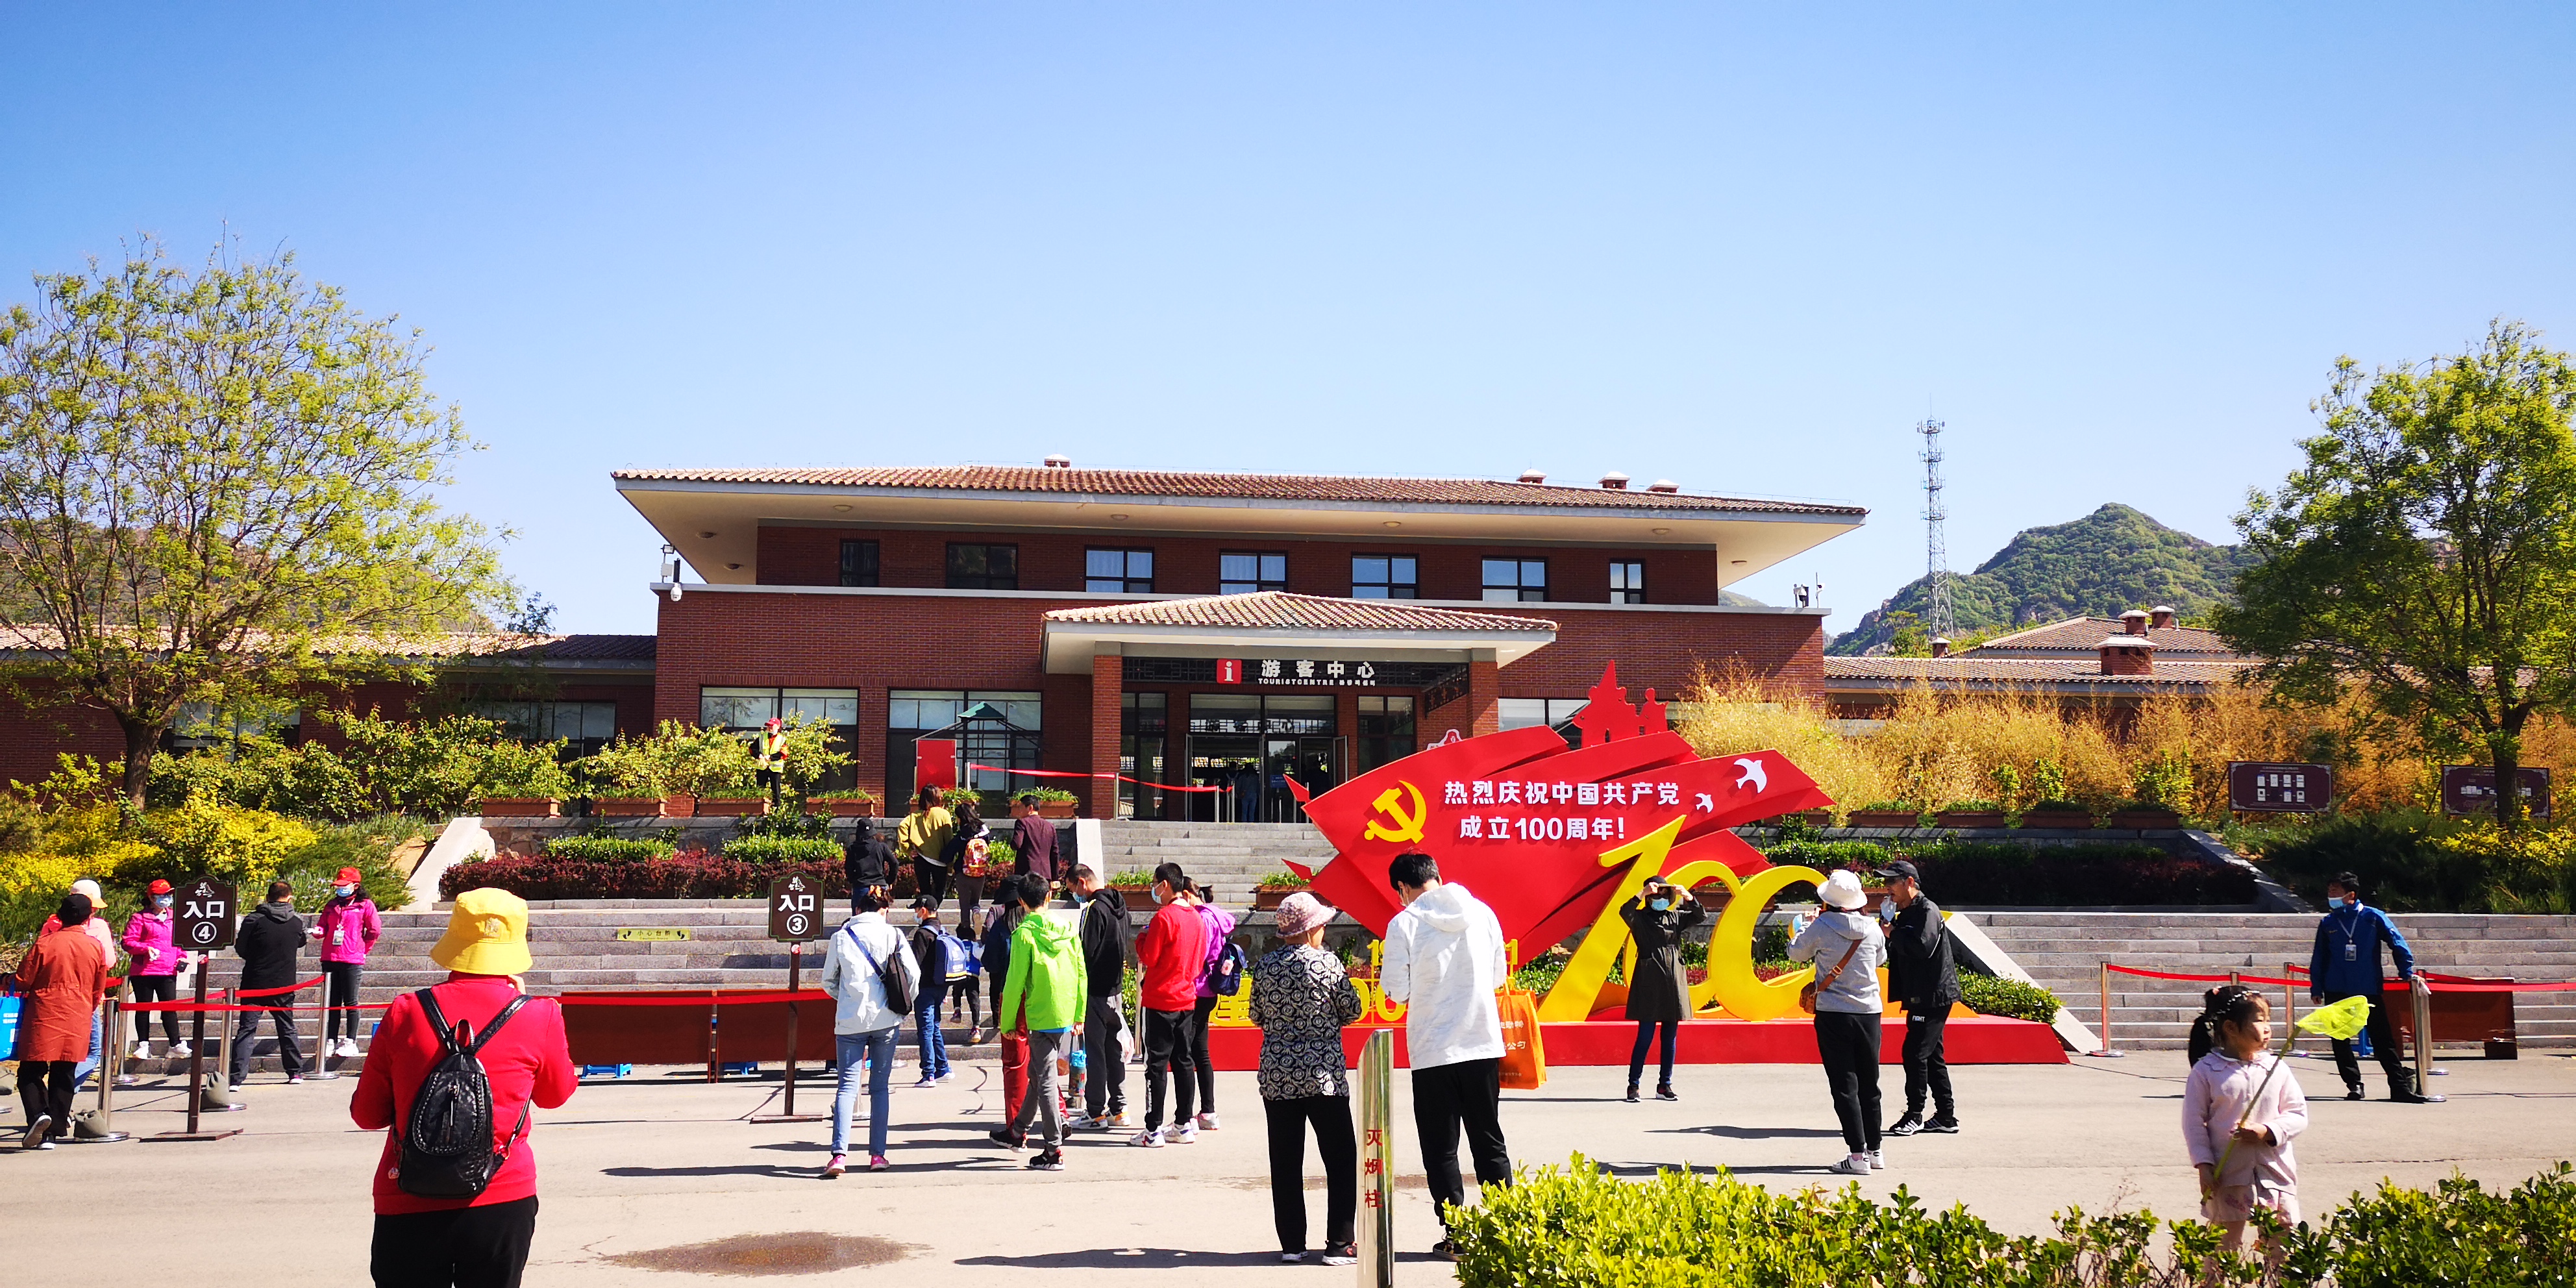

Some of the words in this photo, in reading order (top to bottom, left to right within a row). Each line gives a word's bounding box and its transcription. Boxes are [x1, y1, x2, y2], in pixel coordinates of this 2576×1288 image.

[1261, 660, 1375, 678] 游客中心
[1444, 780, 1680, 806] 热烈庆祝中国共产党
[182, 900, 225, 919] 入口
[778, 895, 814, 912] 入口
[1365, 1129, 1383, 1208] 灭烟柱
